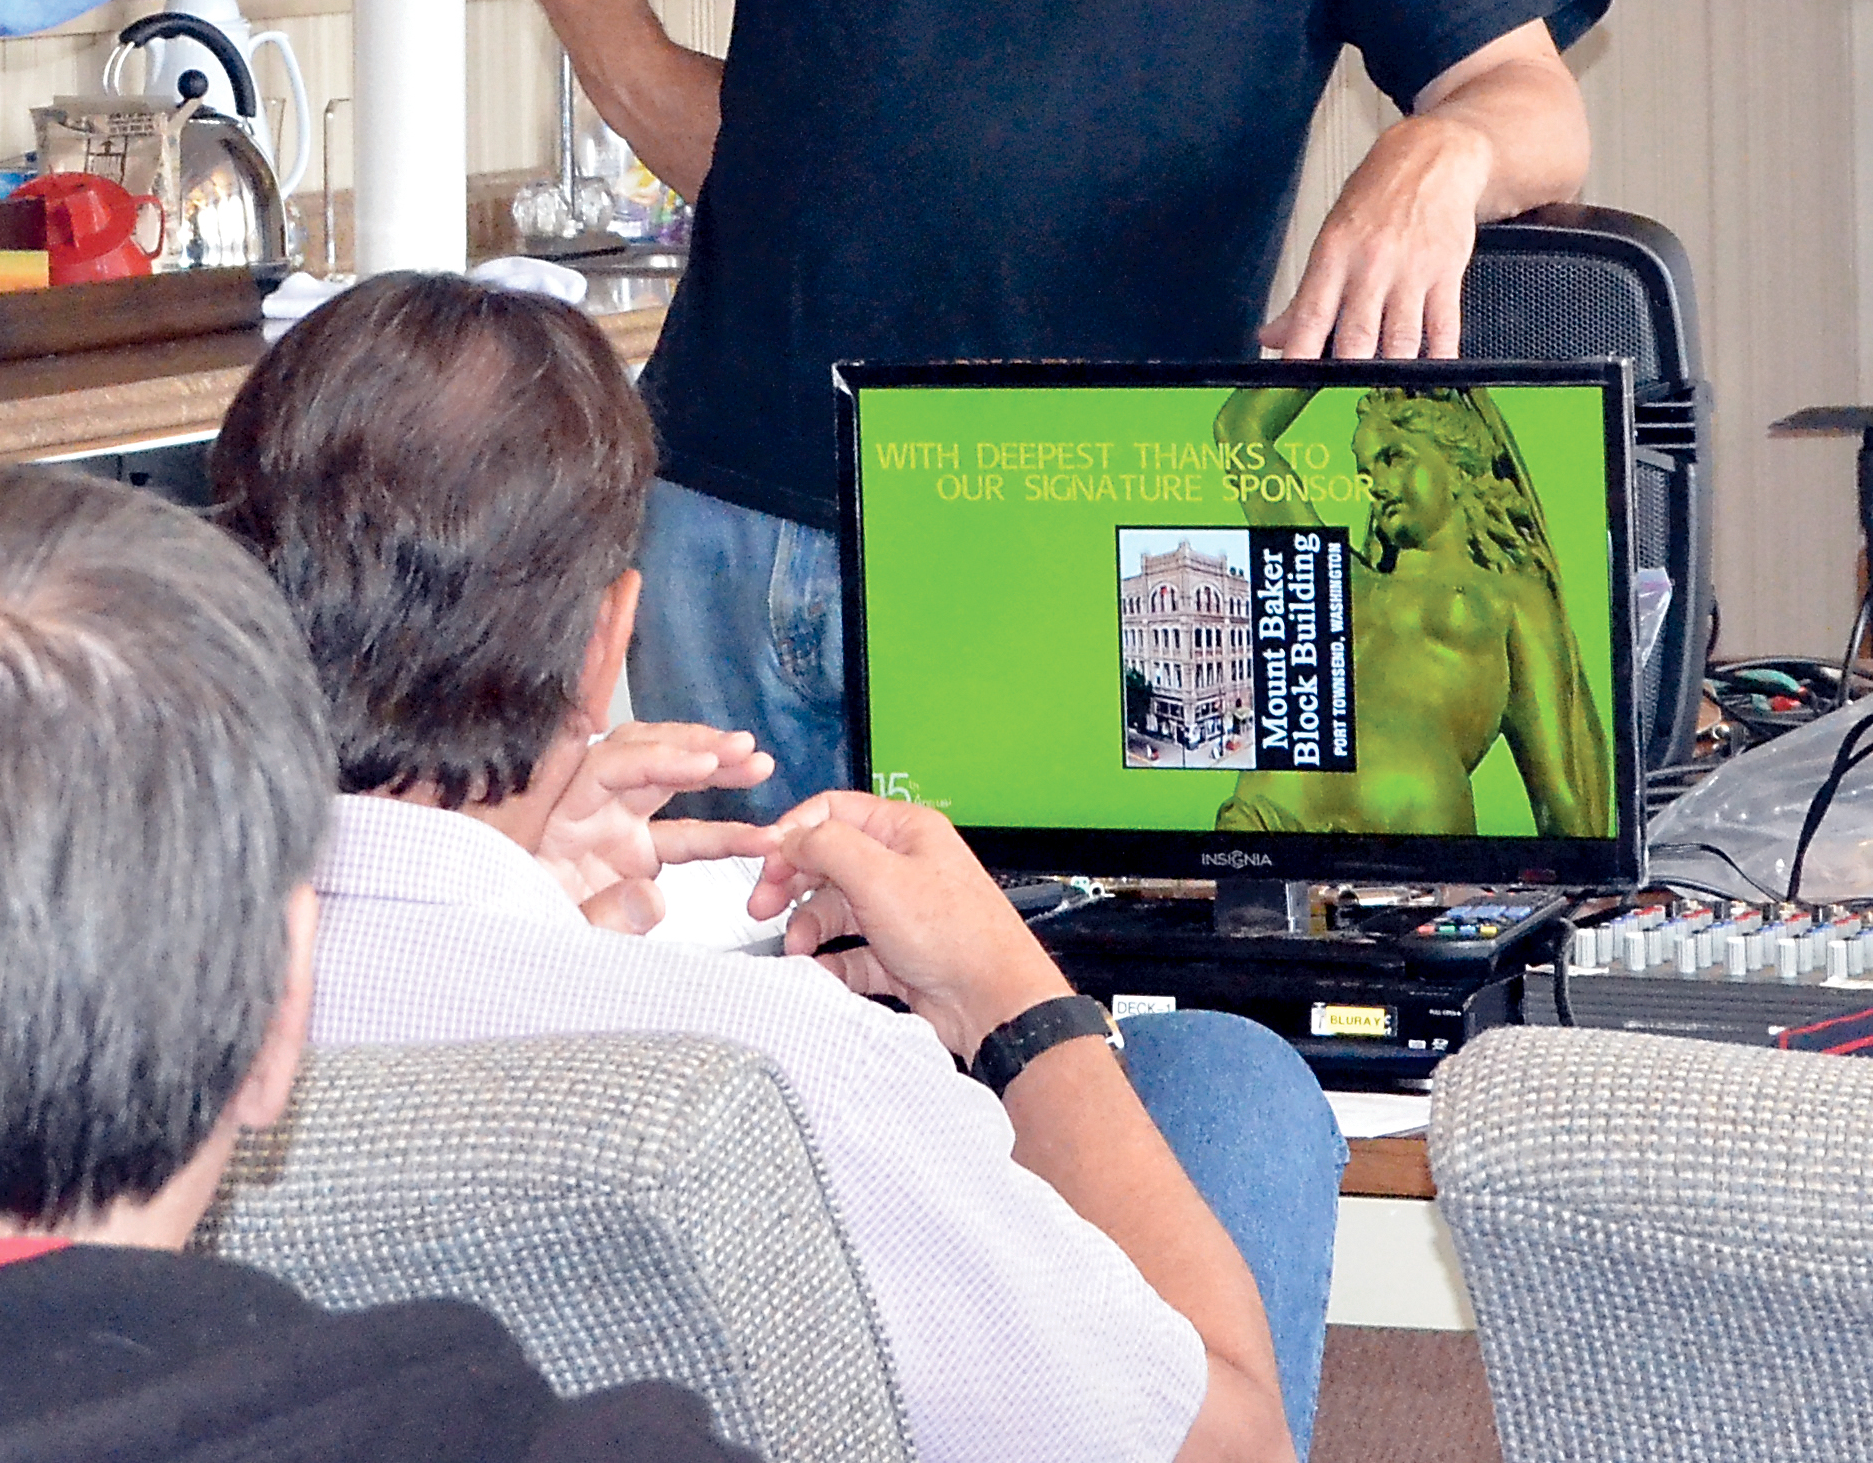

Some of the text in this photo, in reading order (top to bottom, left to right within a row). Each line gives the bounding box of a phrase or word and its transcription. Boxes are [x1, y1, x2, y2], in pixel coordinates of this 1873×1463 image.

[876, 441, 1331, 472] WITH DEEPEST THANKS TO
[936, 473, 1376, 504] OUR SIGNATURE SPONSOR
[1257, 547, 1289, 750] Mount Baker
[1287, 532, 1321, 767] Block Building
[1328, 541, 1348, 758] PORT TOWNSEND, WASHINGTON
[1201, 849, 1274, 870] INSIGNIA
[1117, 1001, 1171, 1014] DECK-1
[1330, 1014, 1383, 1027] BLURAY
